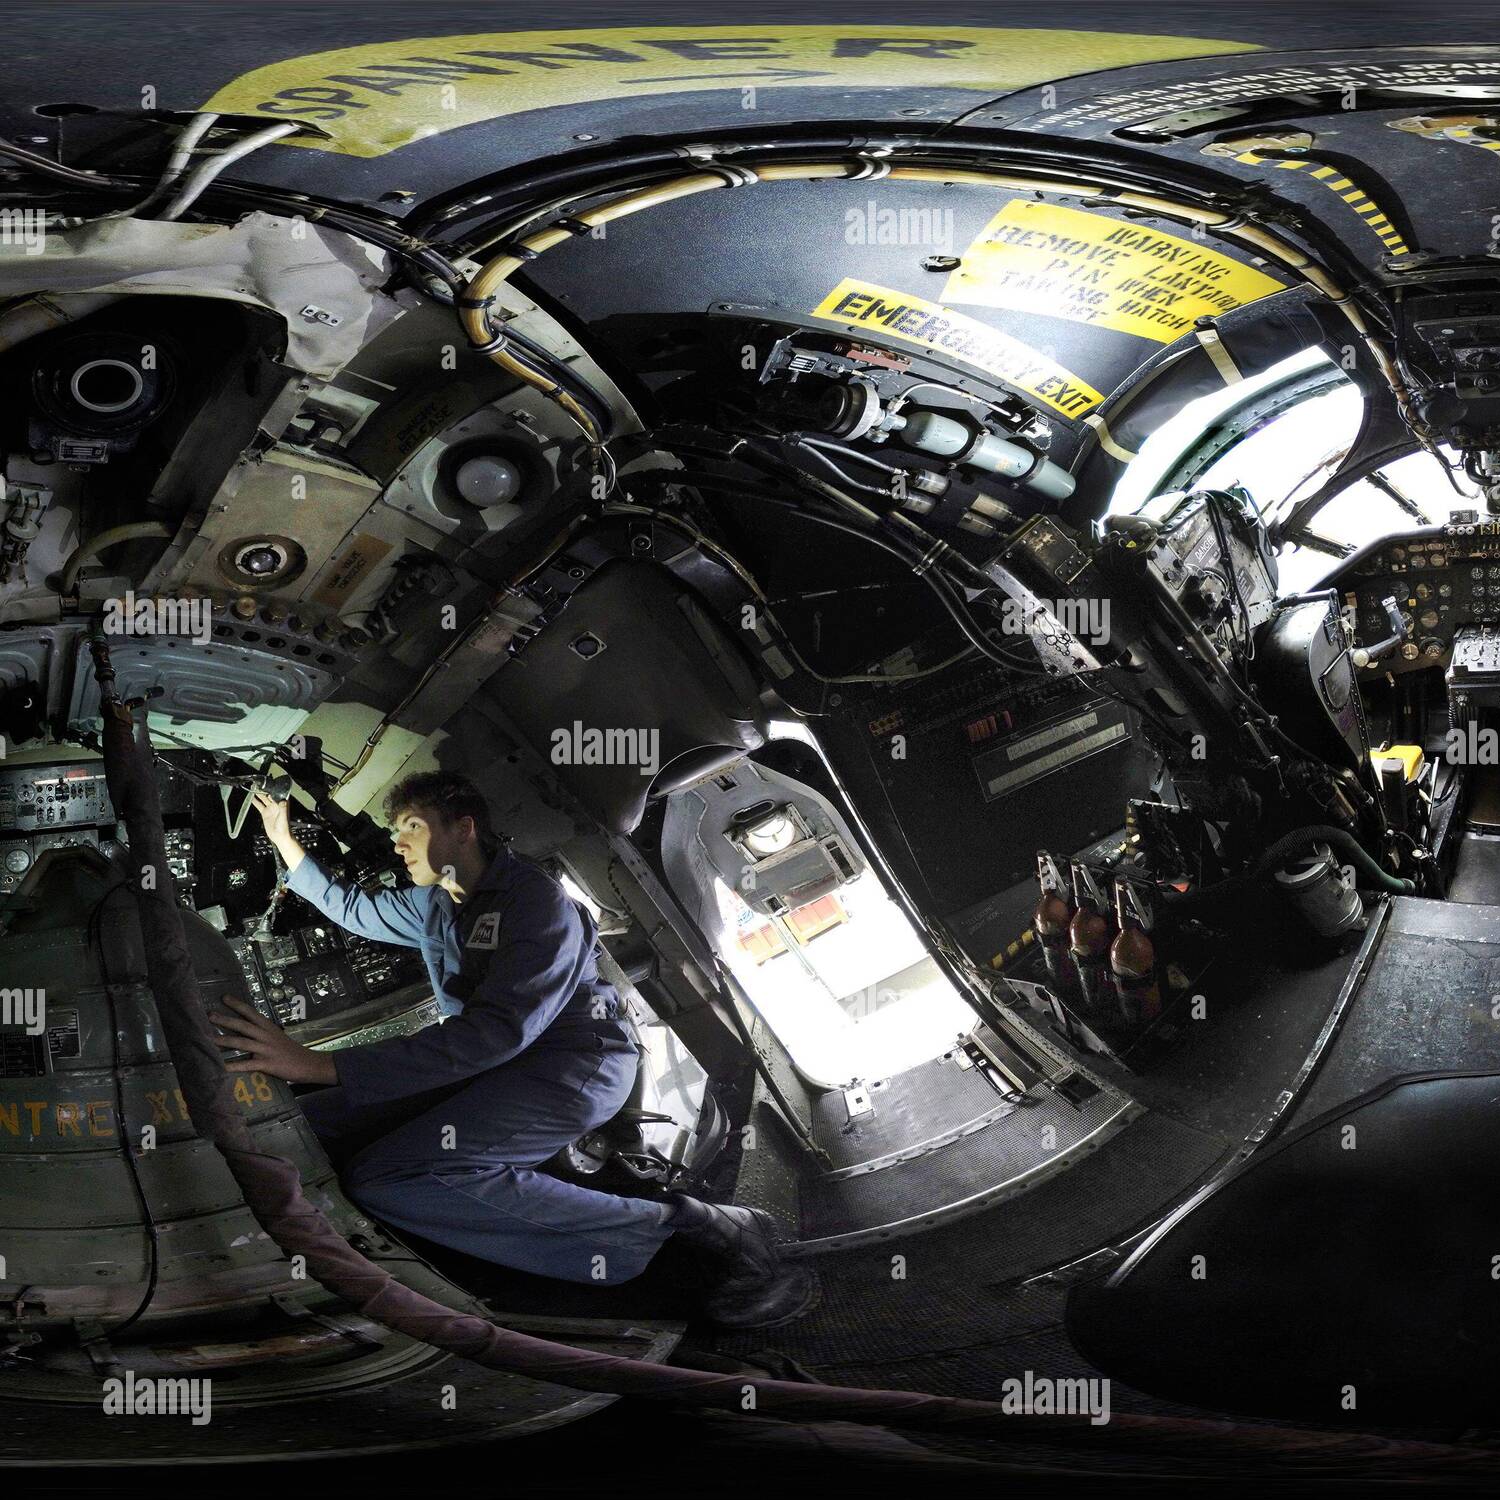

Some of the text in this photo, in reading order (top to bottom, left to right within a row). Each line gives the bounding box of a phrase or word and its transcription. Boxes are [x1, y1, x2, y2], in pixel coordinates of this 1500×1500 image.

[257, 38, 976, 121] SPANNER
[1096, 87, 1167, 106] HATCH
[1329, 64, 1384, 74] FIT
[1148, 89, 1208, 104] TUBE
[1211, 81, 1267, 94] AND
[1186, 79, 1322, 106] OPERATION
[1326, 79, 1369, 90] TO
[1380, 75, 1460, 86] LOCK
[990, 225, 1133, 268] REMOVE
[1104, 227, 1231, 282] WARNING
[1043, 258, 1185, 308] PIN WHEN
[1117, 298, 1193, 331] HATCH
[1034, 375, 1094, 413] EXIT
